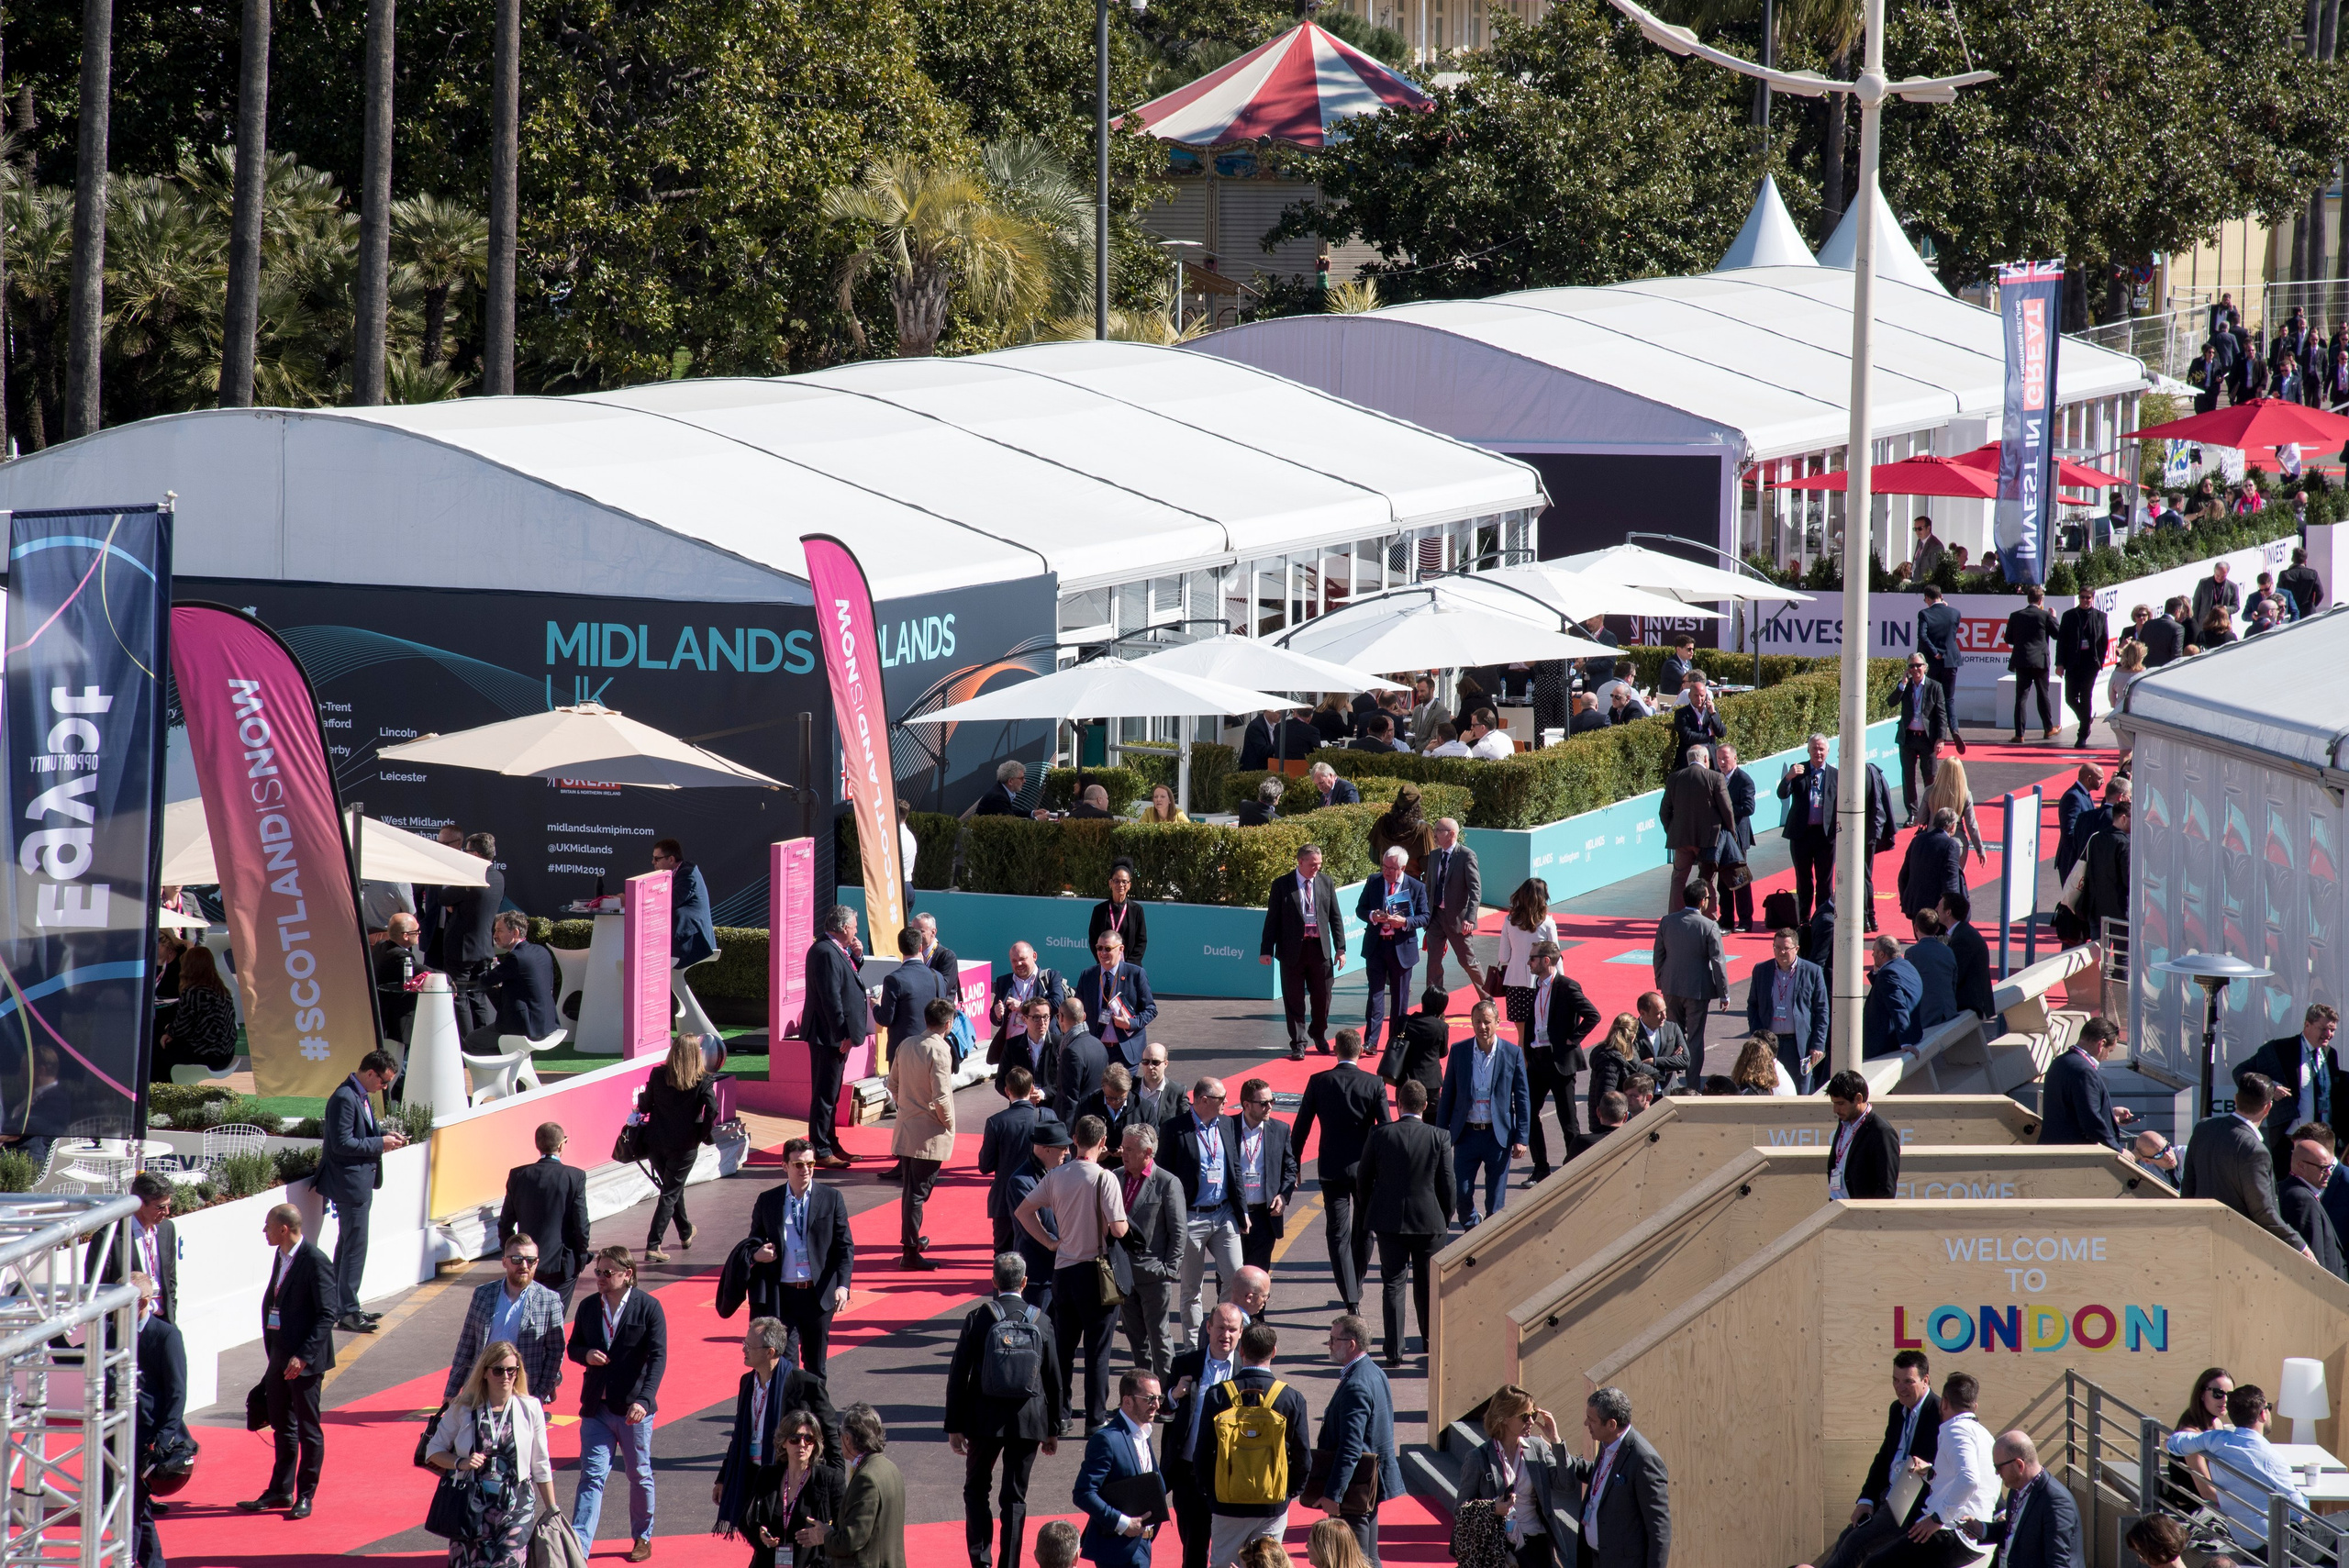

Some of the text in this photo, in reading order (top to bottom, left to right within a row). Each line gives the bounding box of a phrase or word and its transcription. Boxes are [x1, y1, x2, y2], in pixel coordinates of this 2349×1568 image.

[1644, 616, 1708, 631] INVEST
[878, 613, 956, 668] LANDS
[1644, 631, 1662, 646] IN
[1882, 620, 1910, 646] IN
[1956, 622, 2014, 649] REA
[547, 621, 816, 674] MIDLANDS
[546, 674, 614, 710] UK
[323, 718, 352, 728] afford
[380, 727, 417, 738] Lincoln
[329, 745, 351, 757] erby
[380, 772, 428, 783] Leicester
[547, 823, 654, 836] midlandsukmipim.com
[1636, 818, 1655, 833] MIDLANDS
[548, 843, 613, 854] @UKMidlands
[1586, 835, 1606, 851] MIDLANDS
[1532, 852, 1553, 868] MIDLANDS
[228, 678, 331, 1062] #SCOTLANDISNOW
[548, 863, 606, 876] #MIPIM2019
[1046, 936, 1089, 949] Solihull
[1204, 945, 1244, 960] Dudley
[2212, 1100, 2236, 1113] CB
[1945, 1238, 2107, 1262] WELCOME
[2005, 1268, 2047, 1292] TO
[1894, 1305, 2168, 1352] LONDON
